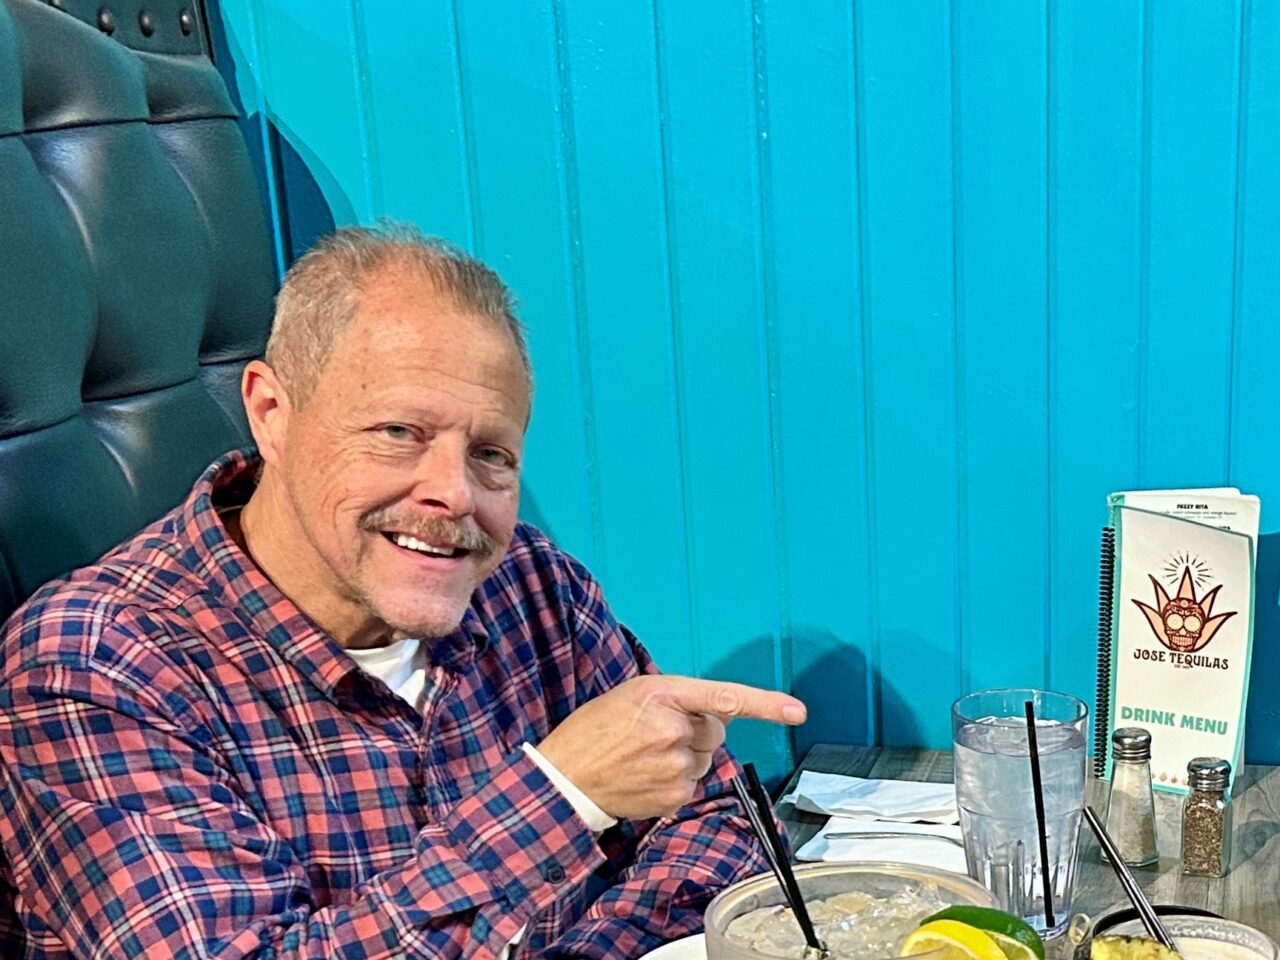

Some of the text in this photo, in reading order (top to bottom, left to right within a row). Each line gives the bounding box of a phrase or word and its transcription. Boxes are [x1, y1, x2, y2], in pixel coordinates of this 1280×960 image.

[1134, 649, 1229, 670] JOSE TEQUILAS
[1121, 706, 1228, 735] DRINK MENU
